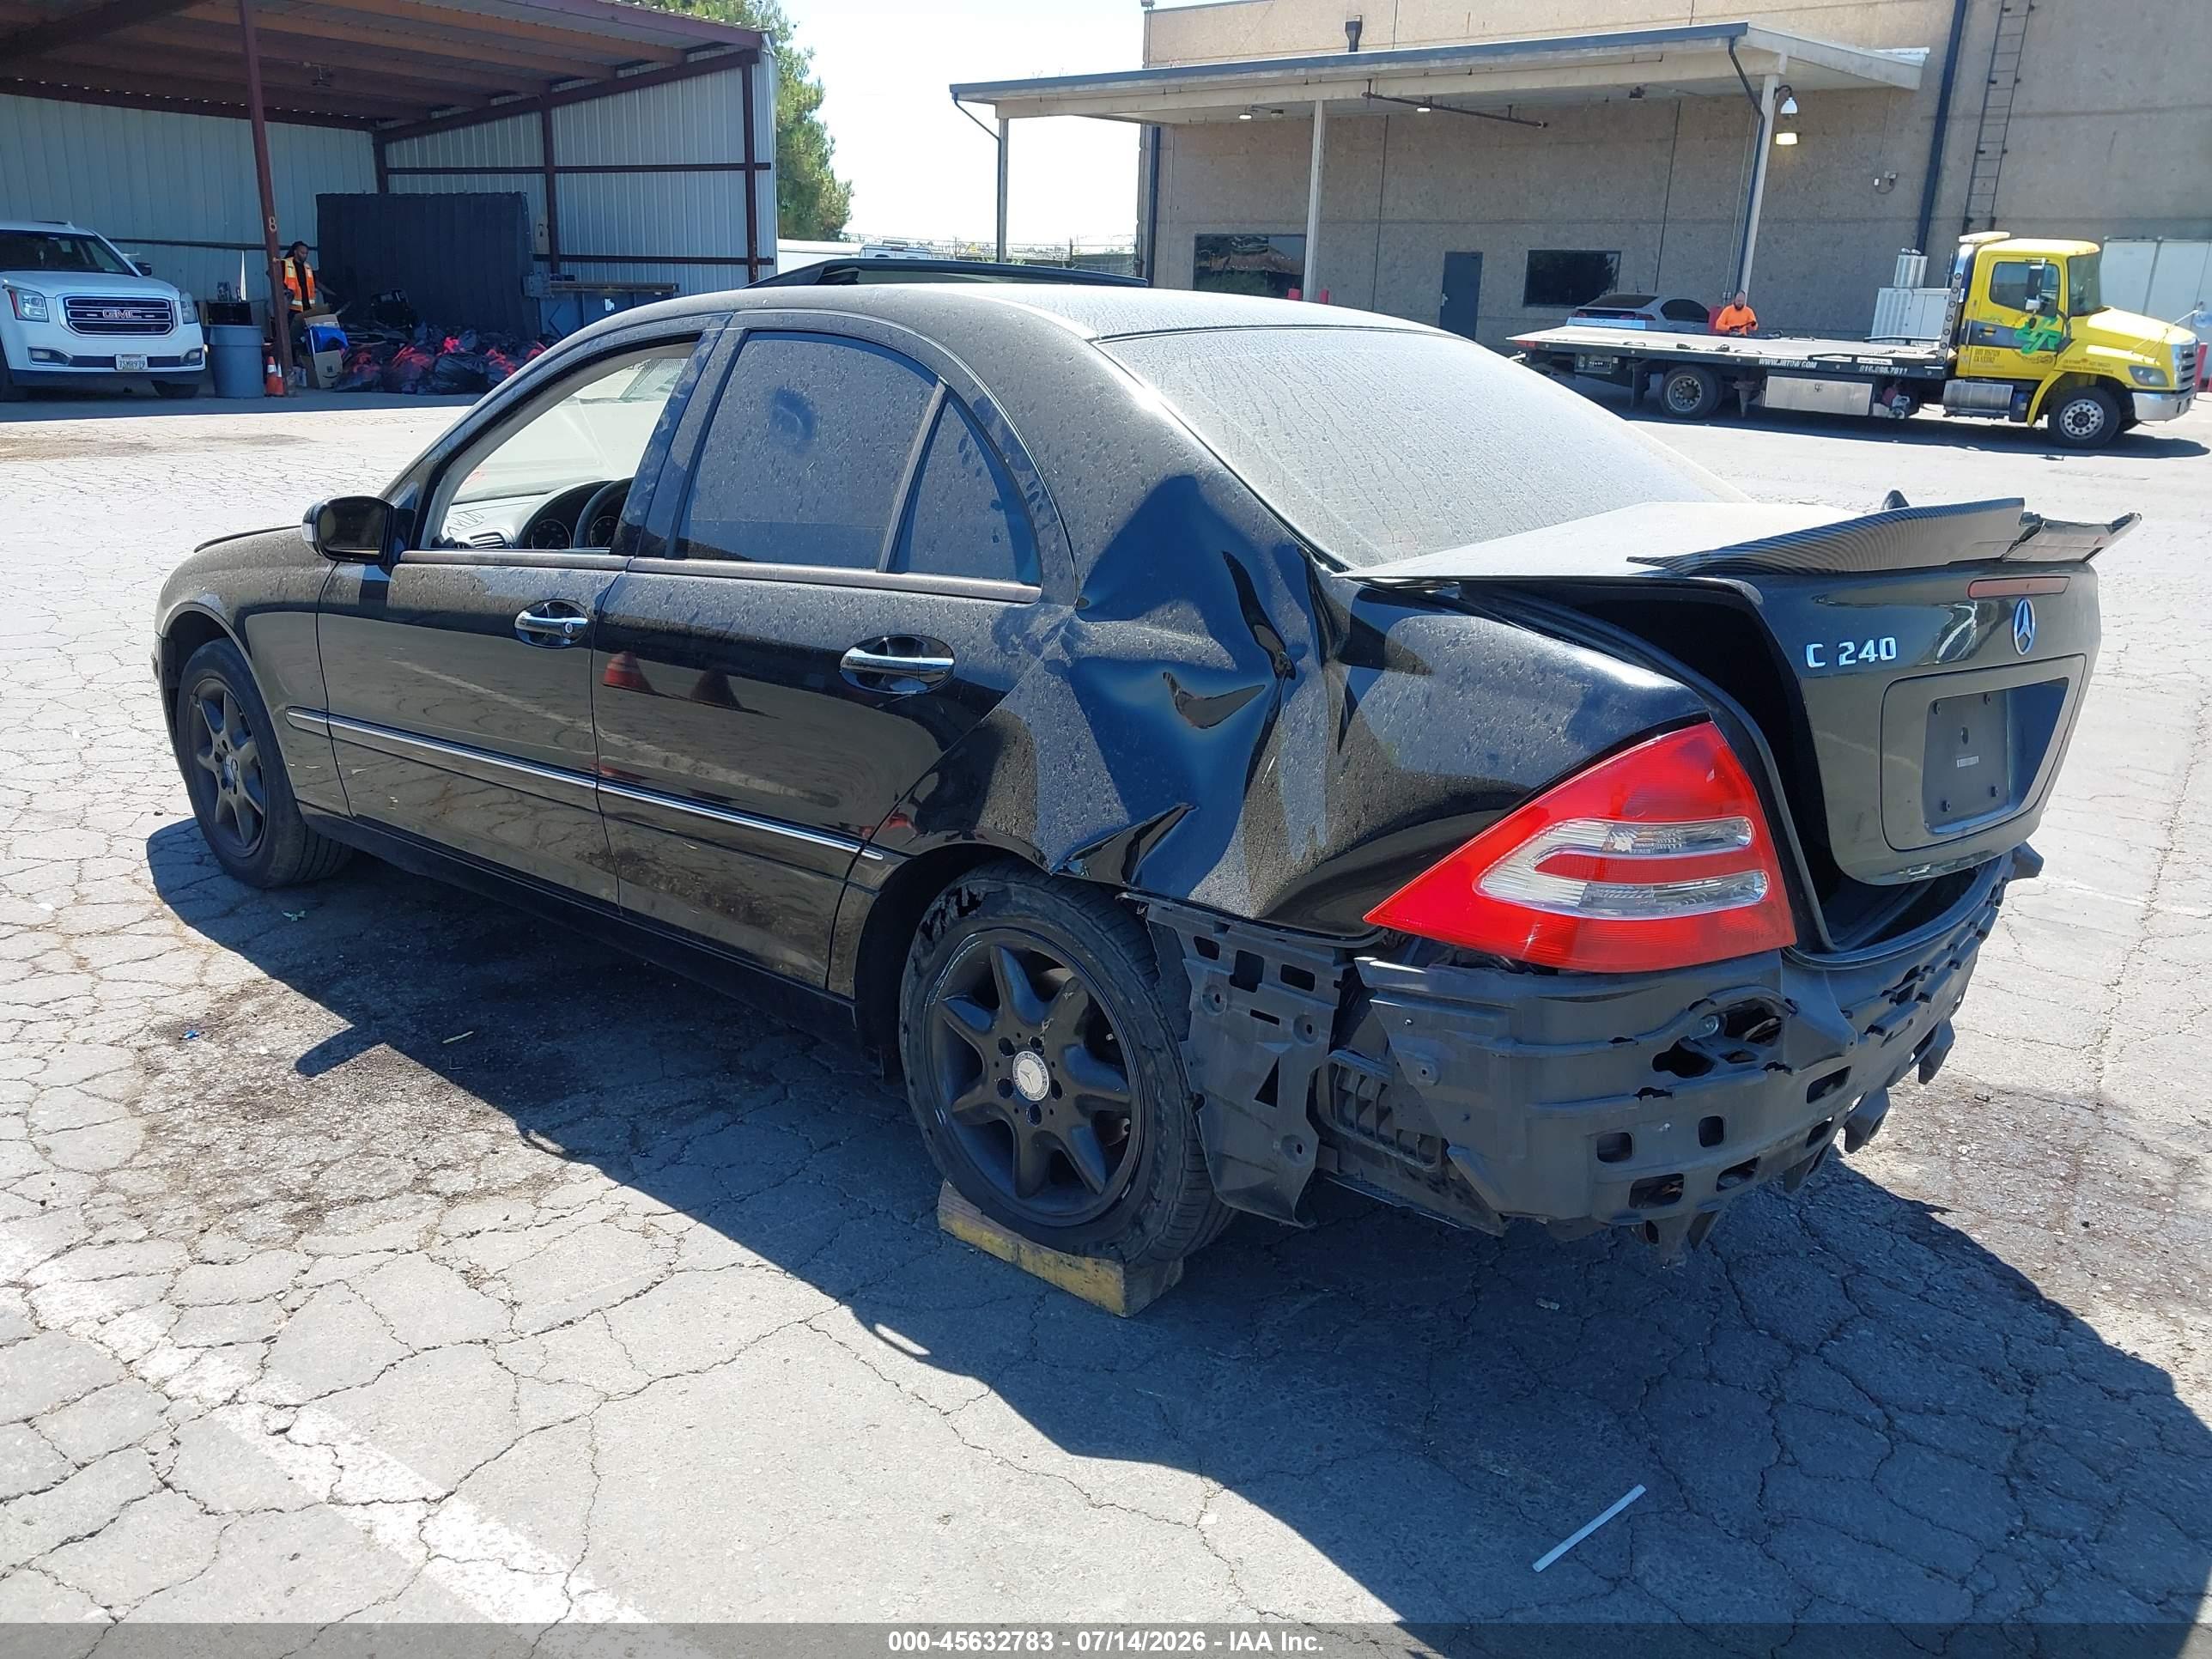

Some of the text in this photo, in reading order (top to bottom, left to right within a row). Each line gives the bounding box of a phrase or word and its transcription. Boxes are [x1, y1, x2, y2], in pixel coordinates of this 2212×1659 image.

[269, 216, 277, 232] 8
[102, 309, 142, 319] GMC
[1806, 636, 1897, 668] C 240
